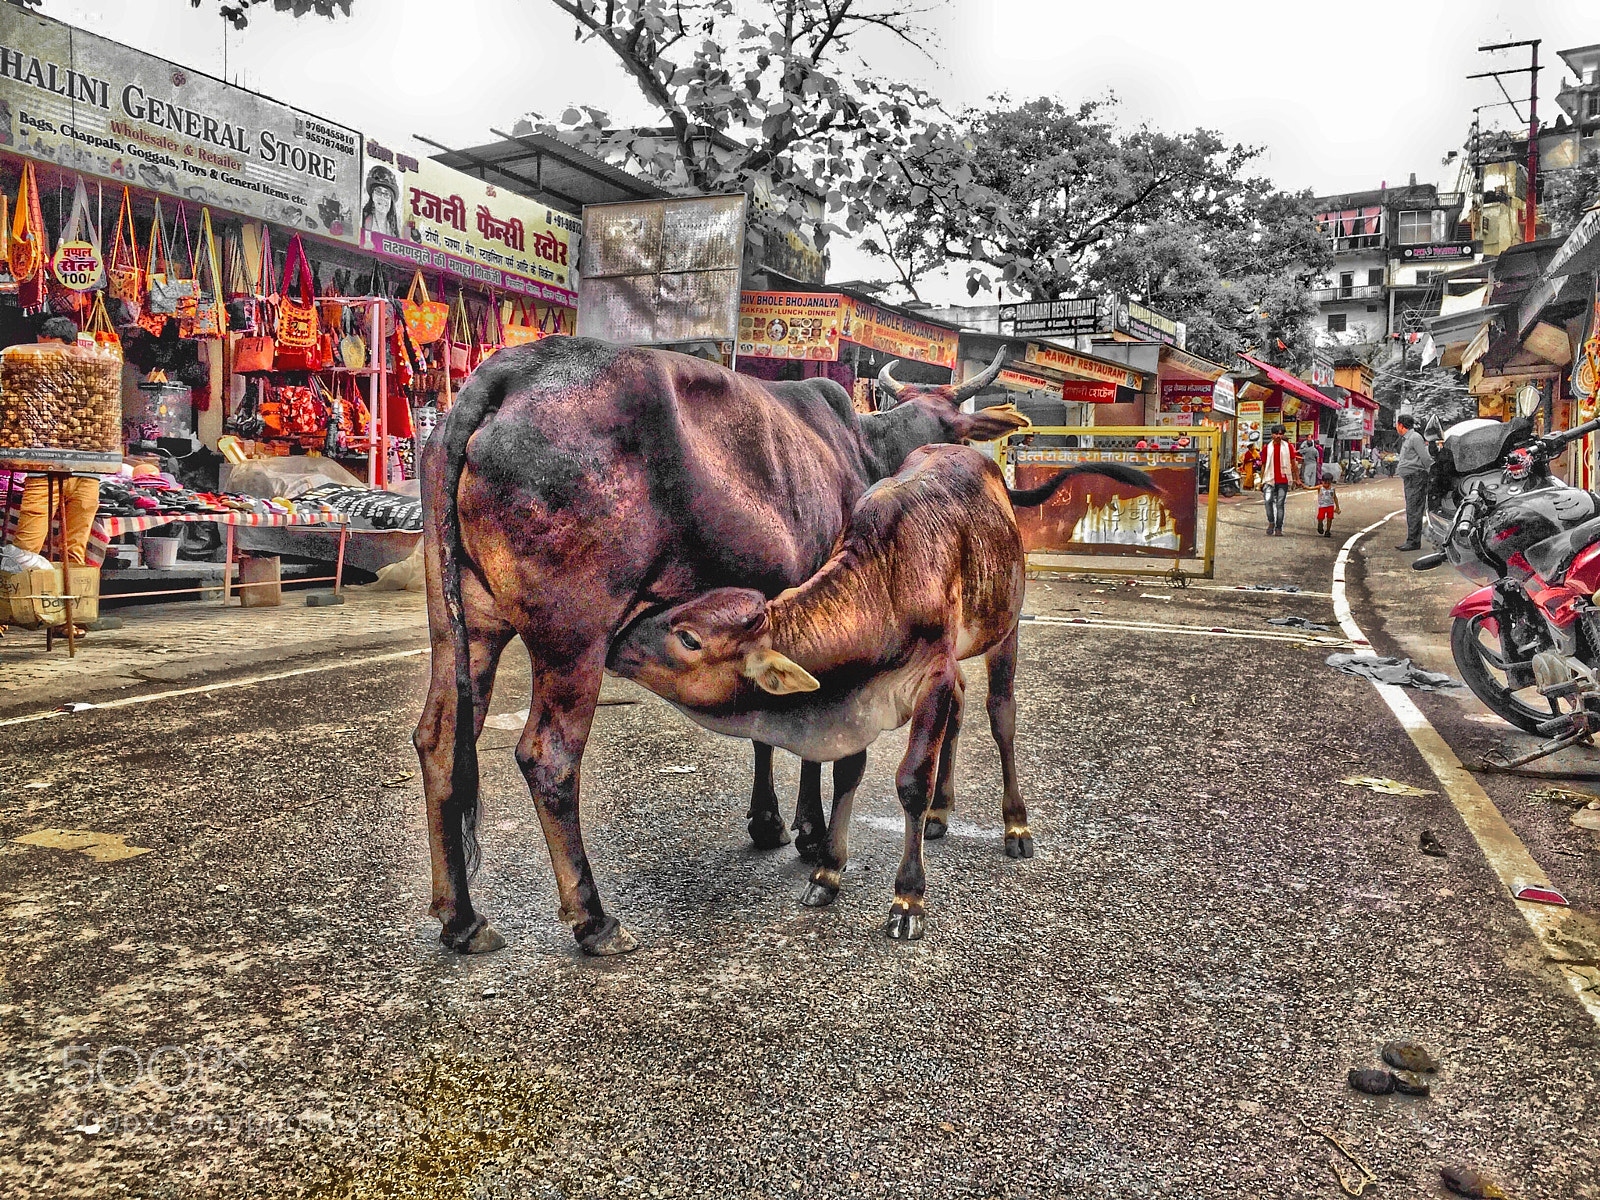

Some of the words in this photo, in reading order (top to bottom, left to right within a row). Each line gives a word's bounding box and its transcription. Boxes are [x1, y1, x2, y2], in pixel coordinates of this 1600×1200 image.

[122, 84, 250, 154] GENERAL
[260, 131, 336, 182] STORE
[305, 121, 354, 145] 9760455810
[305, 131, 354, 155] 9557874808
[111, 120, 179, 151] Wholesaler
[183, 145, 194, 156] &
[199, 148, 242, 171] Retailer
[20, 111, 57, 135] Bags,
[60, 124, 125, 154] Chappals,
[127, 144, 179, 170] Goggals,
[181, 160, 207, 177] Toys
[210, 169, 218, 180] &
[221, 171, 260, 193] General
[262, 184, 289, 201] Items
[291, 193, 308, 206] etc.
[409, 187, 467, 232] रजनी
[476, 204, 525, 252] फैन्सी
[533, 230, 568, 266] स्टोर
[59, 258, 97, 272] सेल
[433, 253, 446, 268] की
[62, 273, 95, 284] 100/-
[756, 295, 784, 306] BHOLE
[786, 296, 839, 308] BHOJANALYA
[855, 303, 875, 322] SHIV
[875, 311, 900, 330] BHOLE
[902, 320, 944, 343] BHOJANALYA
[1044, 349, 1076, 367] RAWAT
[1077, 358, 1127, 380] RESTAURANT
[1145, 451, 1187, 466] पुलिस
